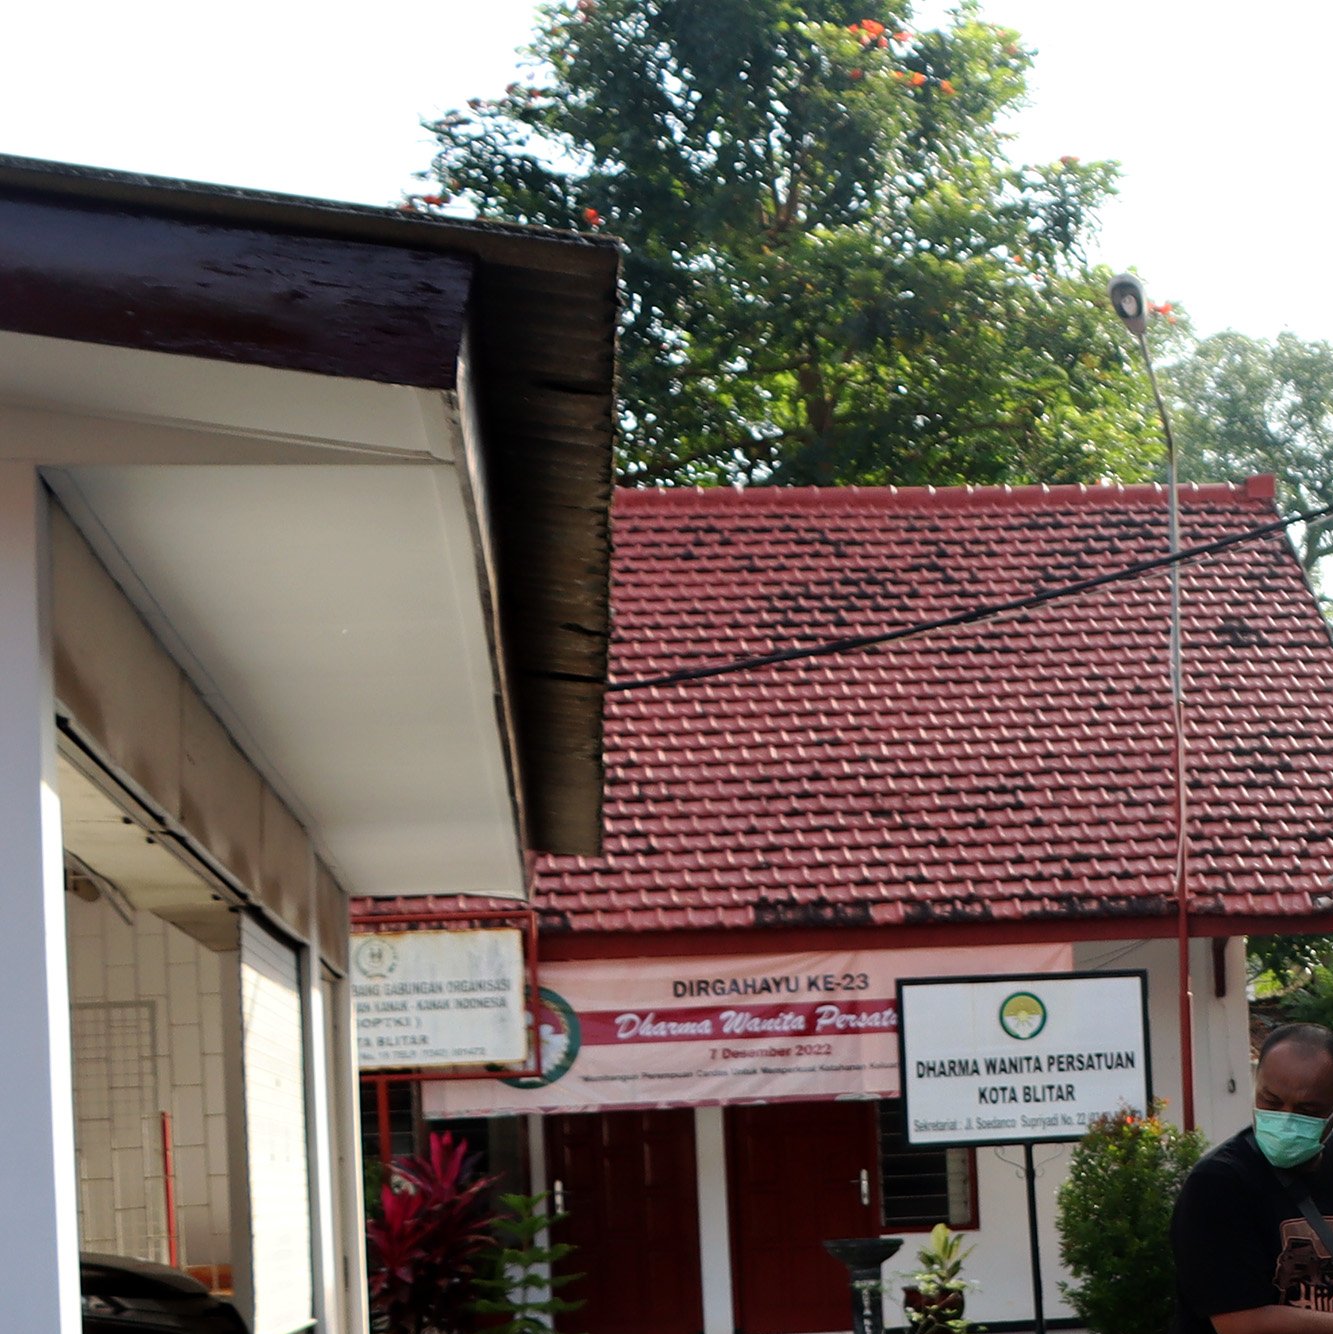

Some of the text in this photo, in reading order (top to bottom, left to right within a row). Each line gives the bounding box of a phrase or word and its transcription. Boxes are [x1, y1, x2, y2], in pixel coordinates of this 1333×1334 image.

[447, 979, 511, 993] ORGANISASI
[673, 974, 869, 998] DIRGAHAYU KE-23
[614, 1011, 712, 1038] Dharma
[719, 1009, 806, 1032] Wanita
[377, 1034, 429, 1046] BLITAR
[709, 1043, 833, 1060] 7 Desember 2022
[916, 1051, 1136, 1079] DHARMA WANITA PERSATUAN
[978, 1084, 1076, 1105] KOTA BLITAR
[913, 1118, 957, 1132] Sekretariat
[976, 1116, 1016, 1129] Soedanco
[1021, 1113, 1059, 1130] Supriyadi
[1076, 1112, 1086, 1124] 22
